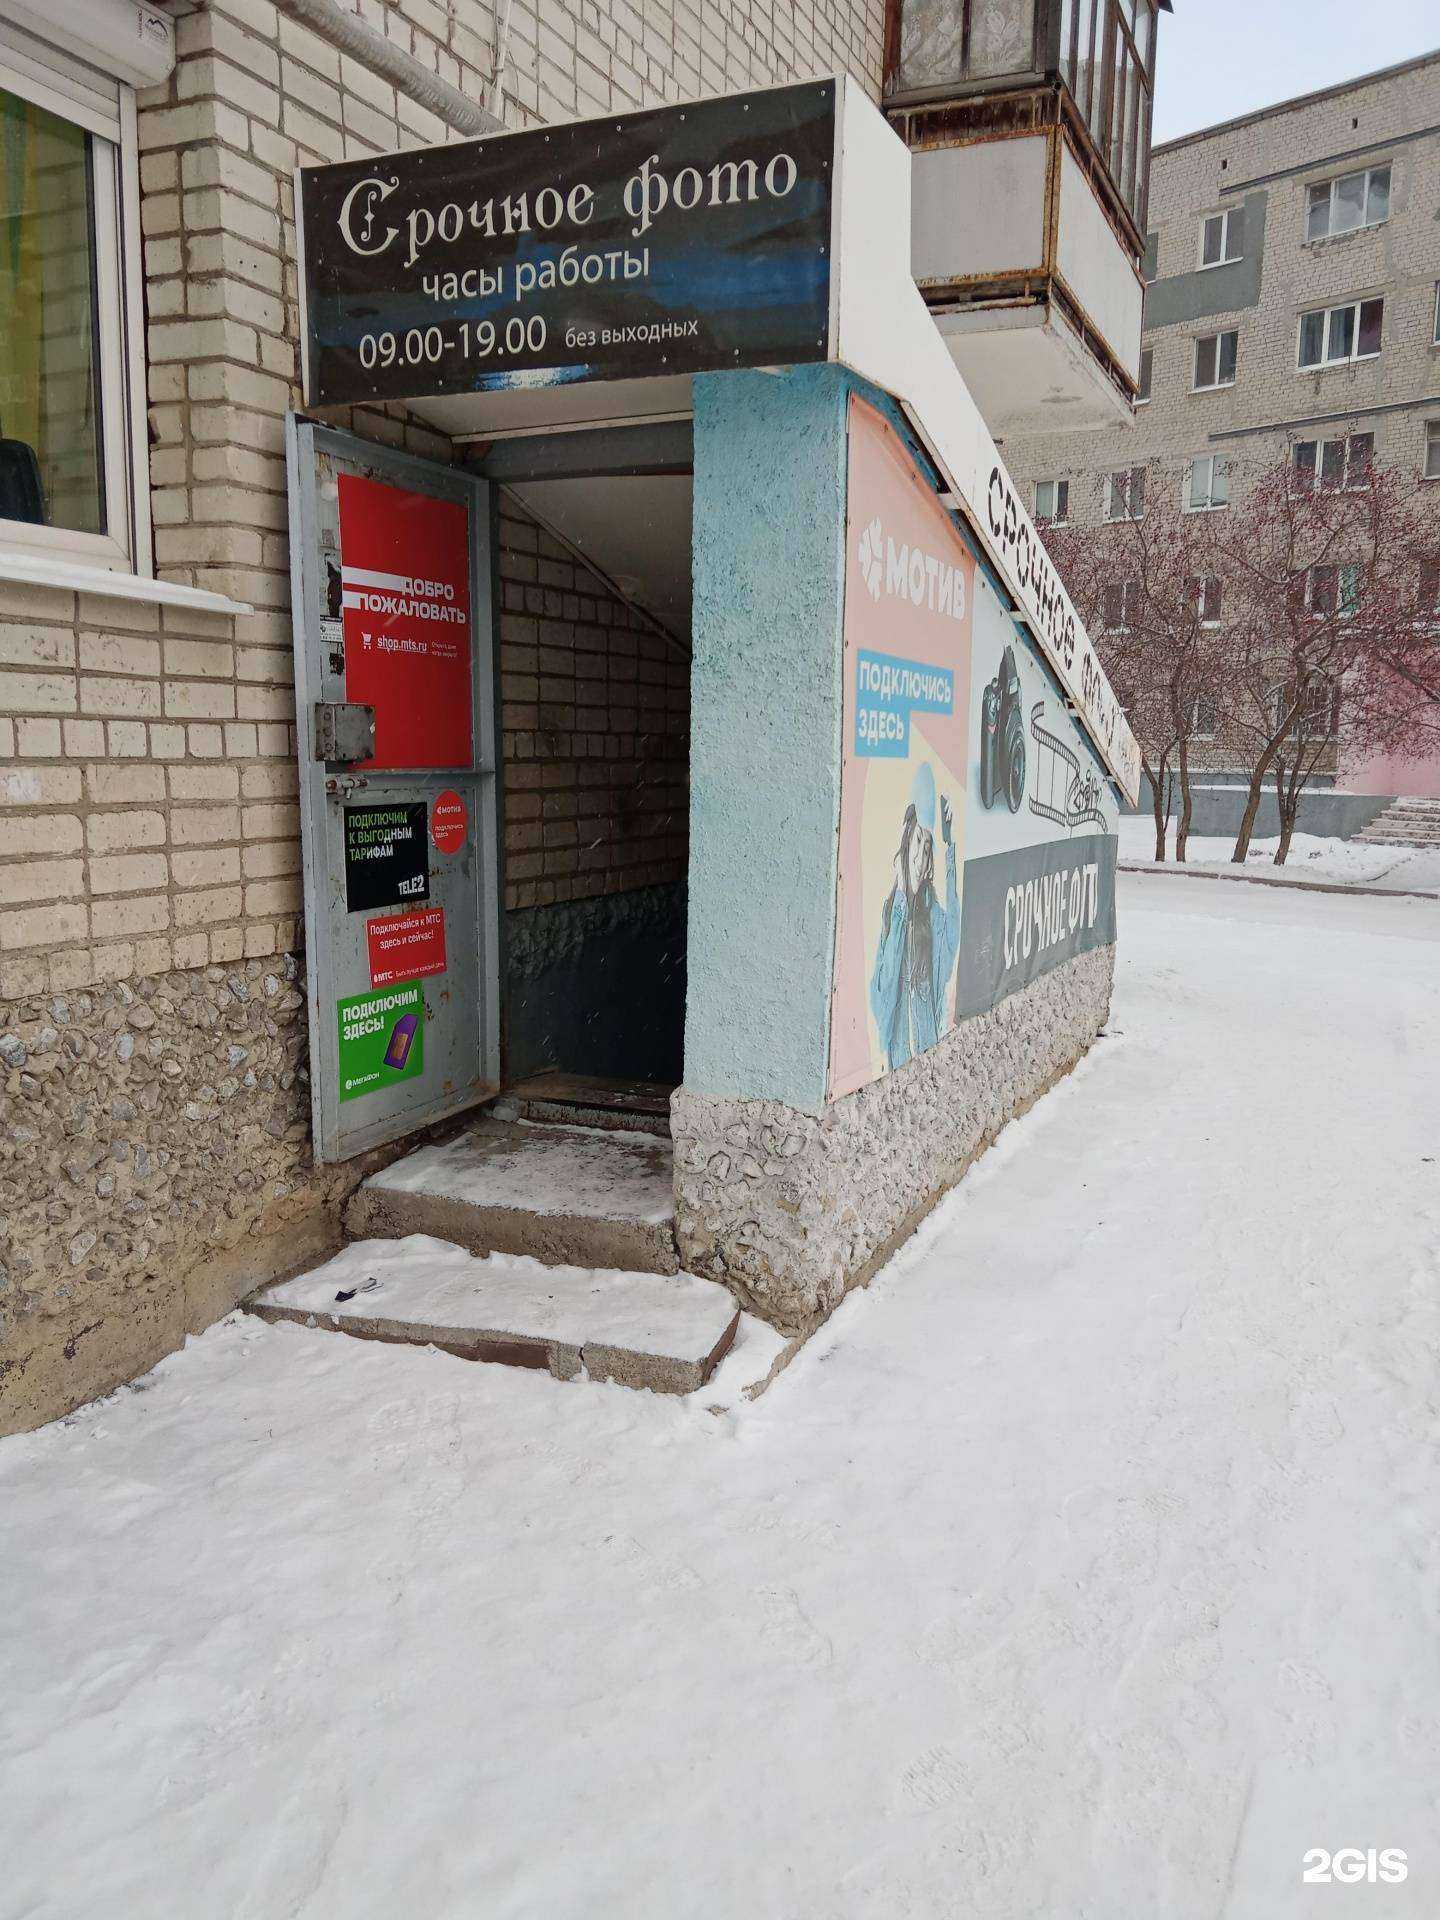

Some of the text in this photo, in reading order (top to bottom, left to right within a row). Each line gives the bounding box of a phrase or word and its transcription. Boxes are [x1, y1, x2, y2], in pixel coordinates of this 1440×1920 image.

[336, 154, 798, 268] Срочное фото
[422, 246, 650, 302] часы работы
[358, 314, 699, 370] 09.00-19.00 без выходных
[399, 576, 455, 601] ДОБРО
[886, 536, 967, 621] МОТИВ
[359, 593, 467, 625] ПОЖАЛОВАТЬ
[377, 635, 428, 655] shop.mts.ru
[859, 660, 952, 704] ПОДКЛЮЧИСЬ
[858, 708, 905, 747] ЗДЕСЬ
[348, 811, 408, 829] ПОДКЛЮЧИМ
[349, 826, 413, 845] К ВЫГОДНЫМ
[349, 844, 394, 861] ТАРИФАМ
[398, 874, 425, 896] TELE2
[370, 916, 420, 936] Подключайся
[425, 913, 441, 925] МТС
[379, 938, 402, 950] здесь
[407, 930, 434, 944] сейчас!
[378, 970, 393, 982] МТС
[342, 989, 418, 1023] ПОДКЛЮЧИМ
[343, 1016, 385, 1041] ЗДЕСЬ!
